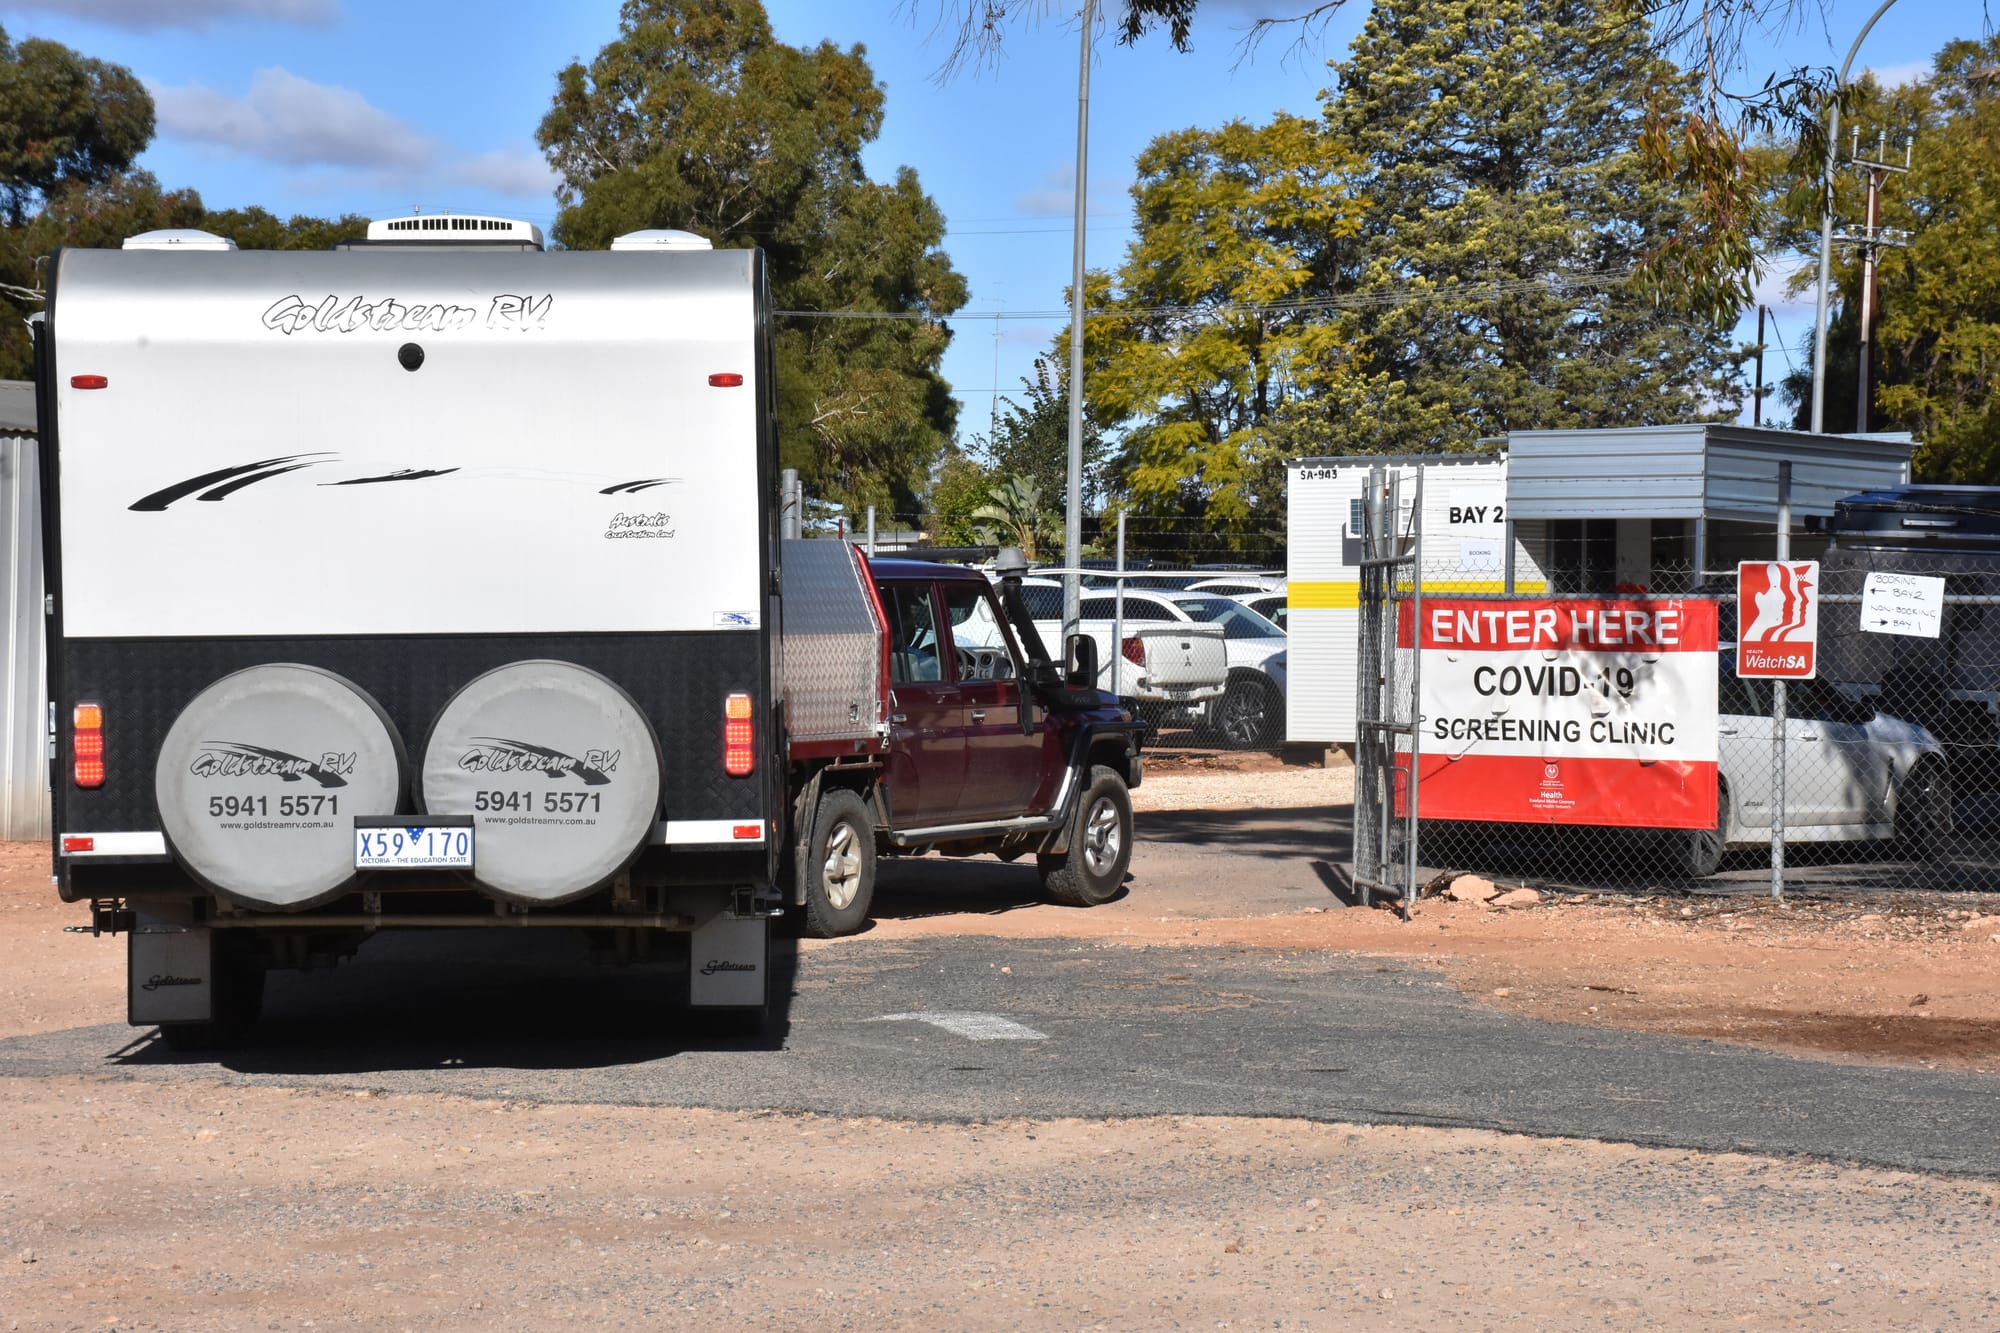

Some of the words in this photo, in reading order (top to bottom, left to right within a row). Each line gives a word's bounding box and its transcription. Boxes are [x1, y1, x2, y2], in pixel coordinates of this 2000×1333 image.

[262, 294, 477, 335] Goldstream
[1300, 469, 1338, 480] SA-943
[1450, 506, 1488, 524] BAY
[1493, 506, 1504, 523] 2
[1874, 574, 1916, 585] BOOKING
[1431, 608, 1558, 644] ENTER
[1570, 609, 1680, 645] HERE
[1893, 619, 1911, 630] BAY
[1745, 655, 1807, 669] WatchSA
[1473, 665, 1635, 698] COVID-19
[1434, 717, 1581, 743] SCREENING
[1590, 720, 1675, 745] CLINIC
[190, 753, 312, 778] Goldstream
[458, 747, 577, 773] Goldstream
[209, 795, 268, 817] 5941
[279, 795, 338, 816] 5571
[474, 791, 532, 812] 5941
[543, 791, 601, 813] 5571
[220, 821, 334, 831] www.goldstreamrv.com.au
[485, 816, 596, 826] www.goldstreamrv.com.au
[361, 833, 404, 857] X59
[427, 832, 468, 857] 170
